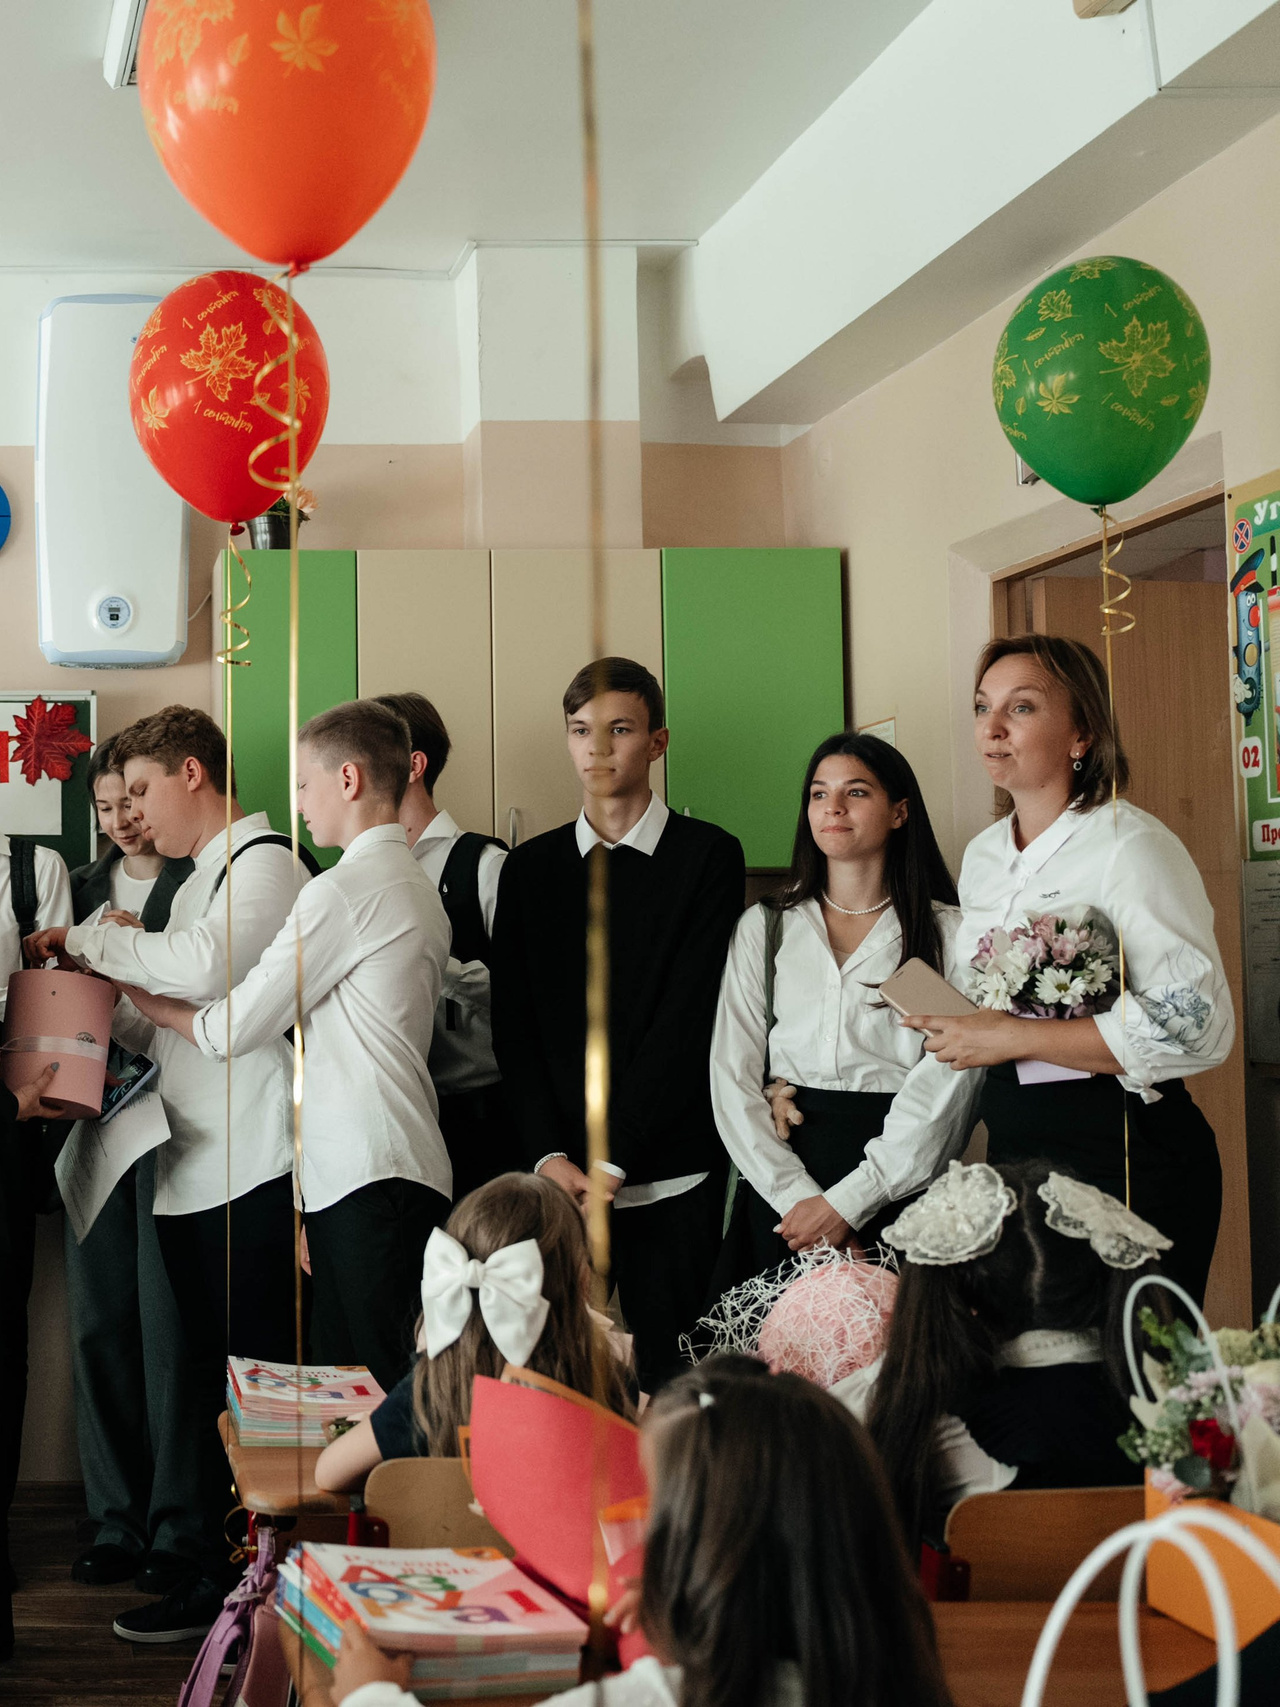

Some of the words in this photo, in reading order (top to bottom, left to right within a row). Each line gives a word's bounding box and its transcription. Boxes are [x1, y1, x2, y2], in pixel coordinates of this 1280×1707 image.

[1104, 303, 1118, 318] 1
[182, 317, 194, 330] 1
[1022, 359, 1032, 375] 1
[1034, 331, 1085, 369] сентября
[1101, 392, 1113, 405] 1
[193, 400, 202, 414] 1
[203, 408, 253, 433] сентября
[1242, 745, 1260, 770] 02
